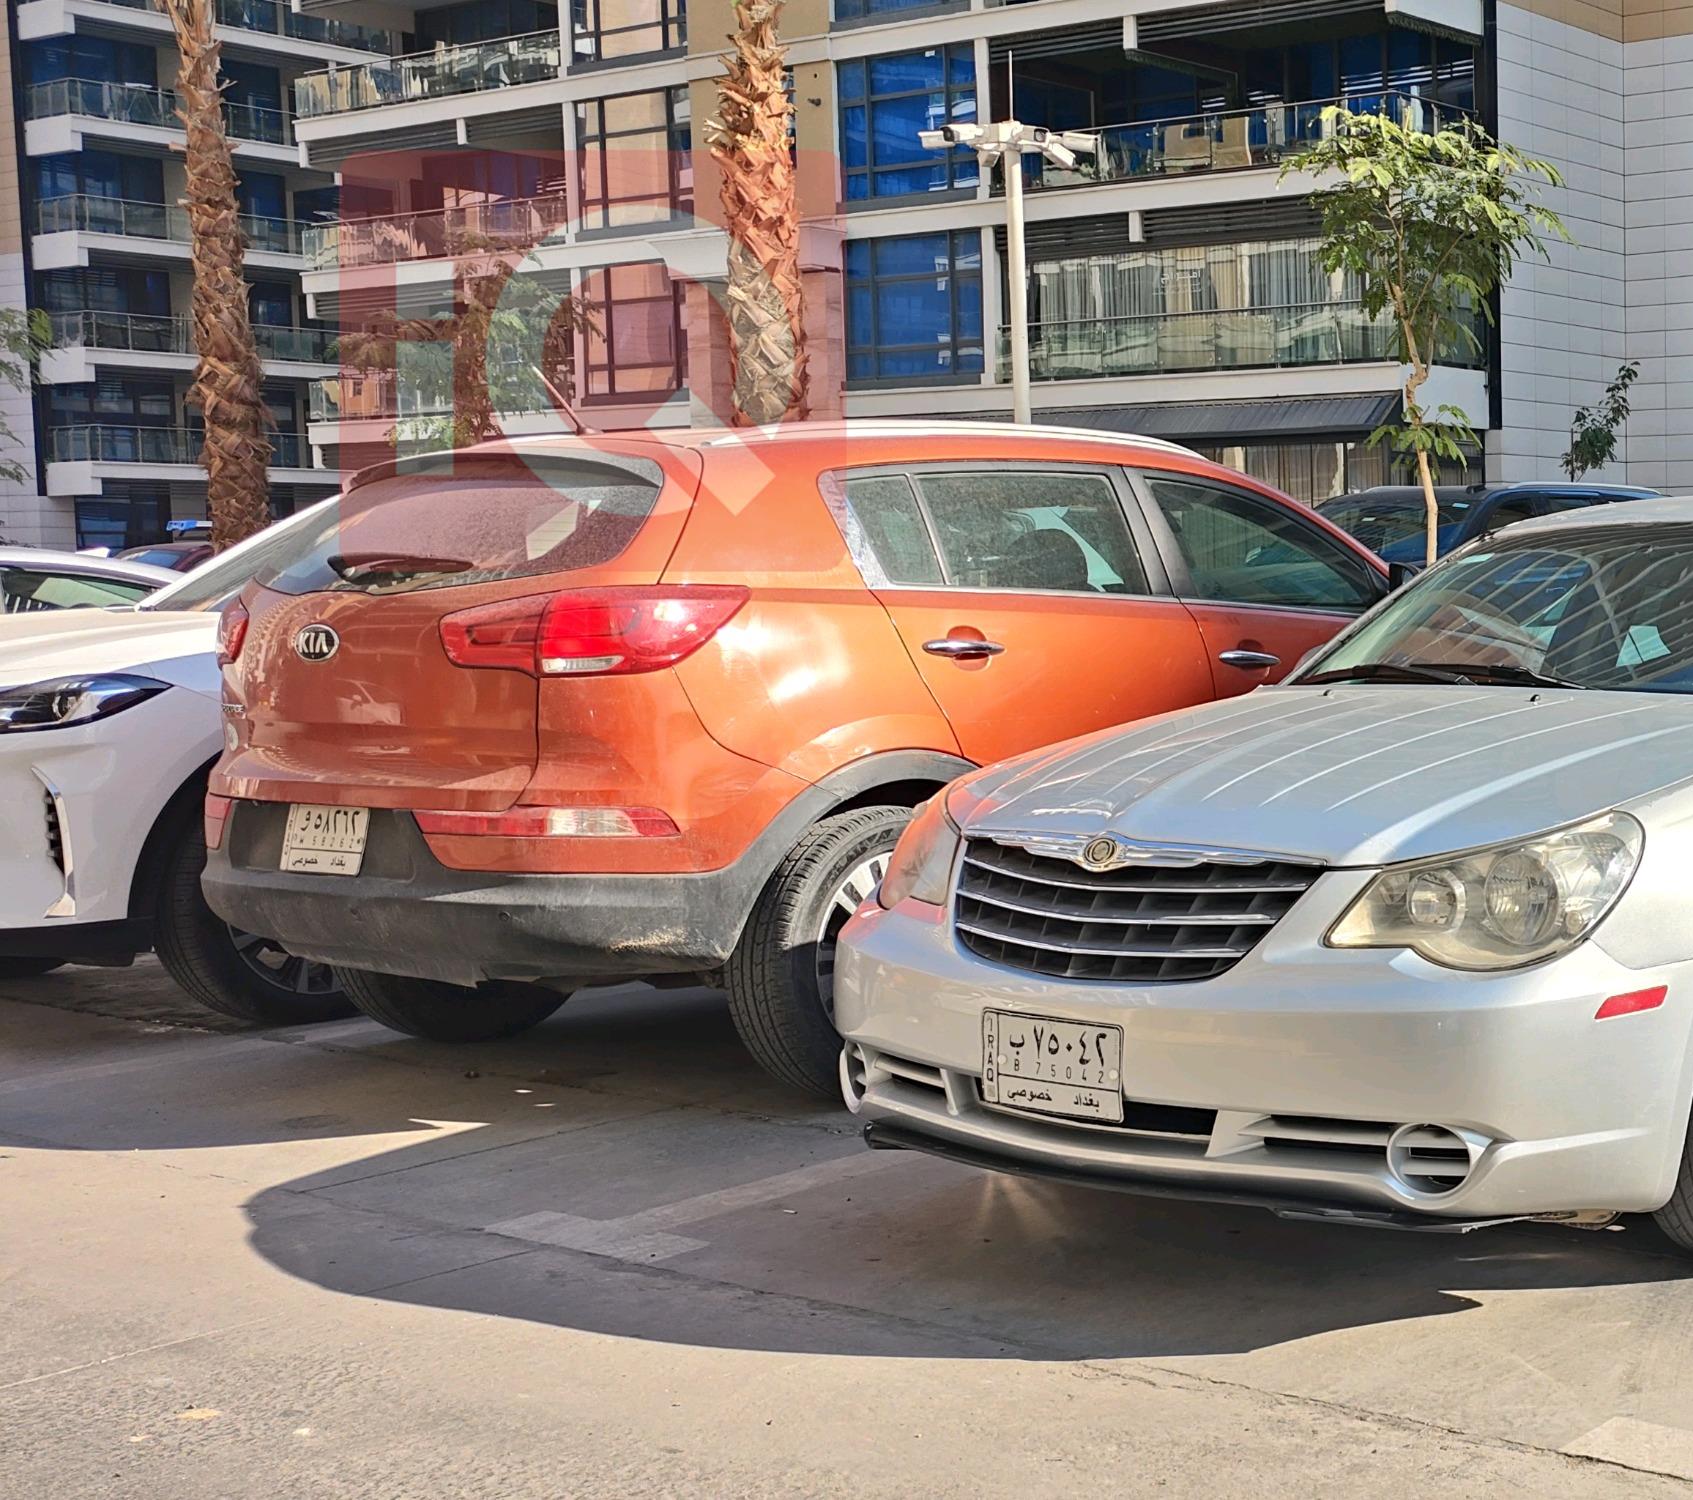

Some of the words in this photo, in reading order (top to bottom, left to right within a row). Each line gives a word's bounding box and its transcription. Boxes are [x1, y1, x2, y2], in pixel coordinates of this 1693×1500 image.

[298, 632, 329, 653] KIA
[986, 1016, 996, 1083] IRAQ
[1007, 1087, 1053, 1103] خصوصي
[1073, 1092, 1100, 1113] بغداد
